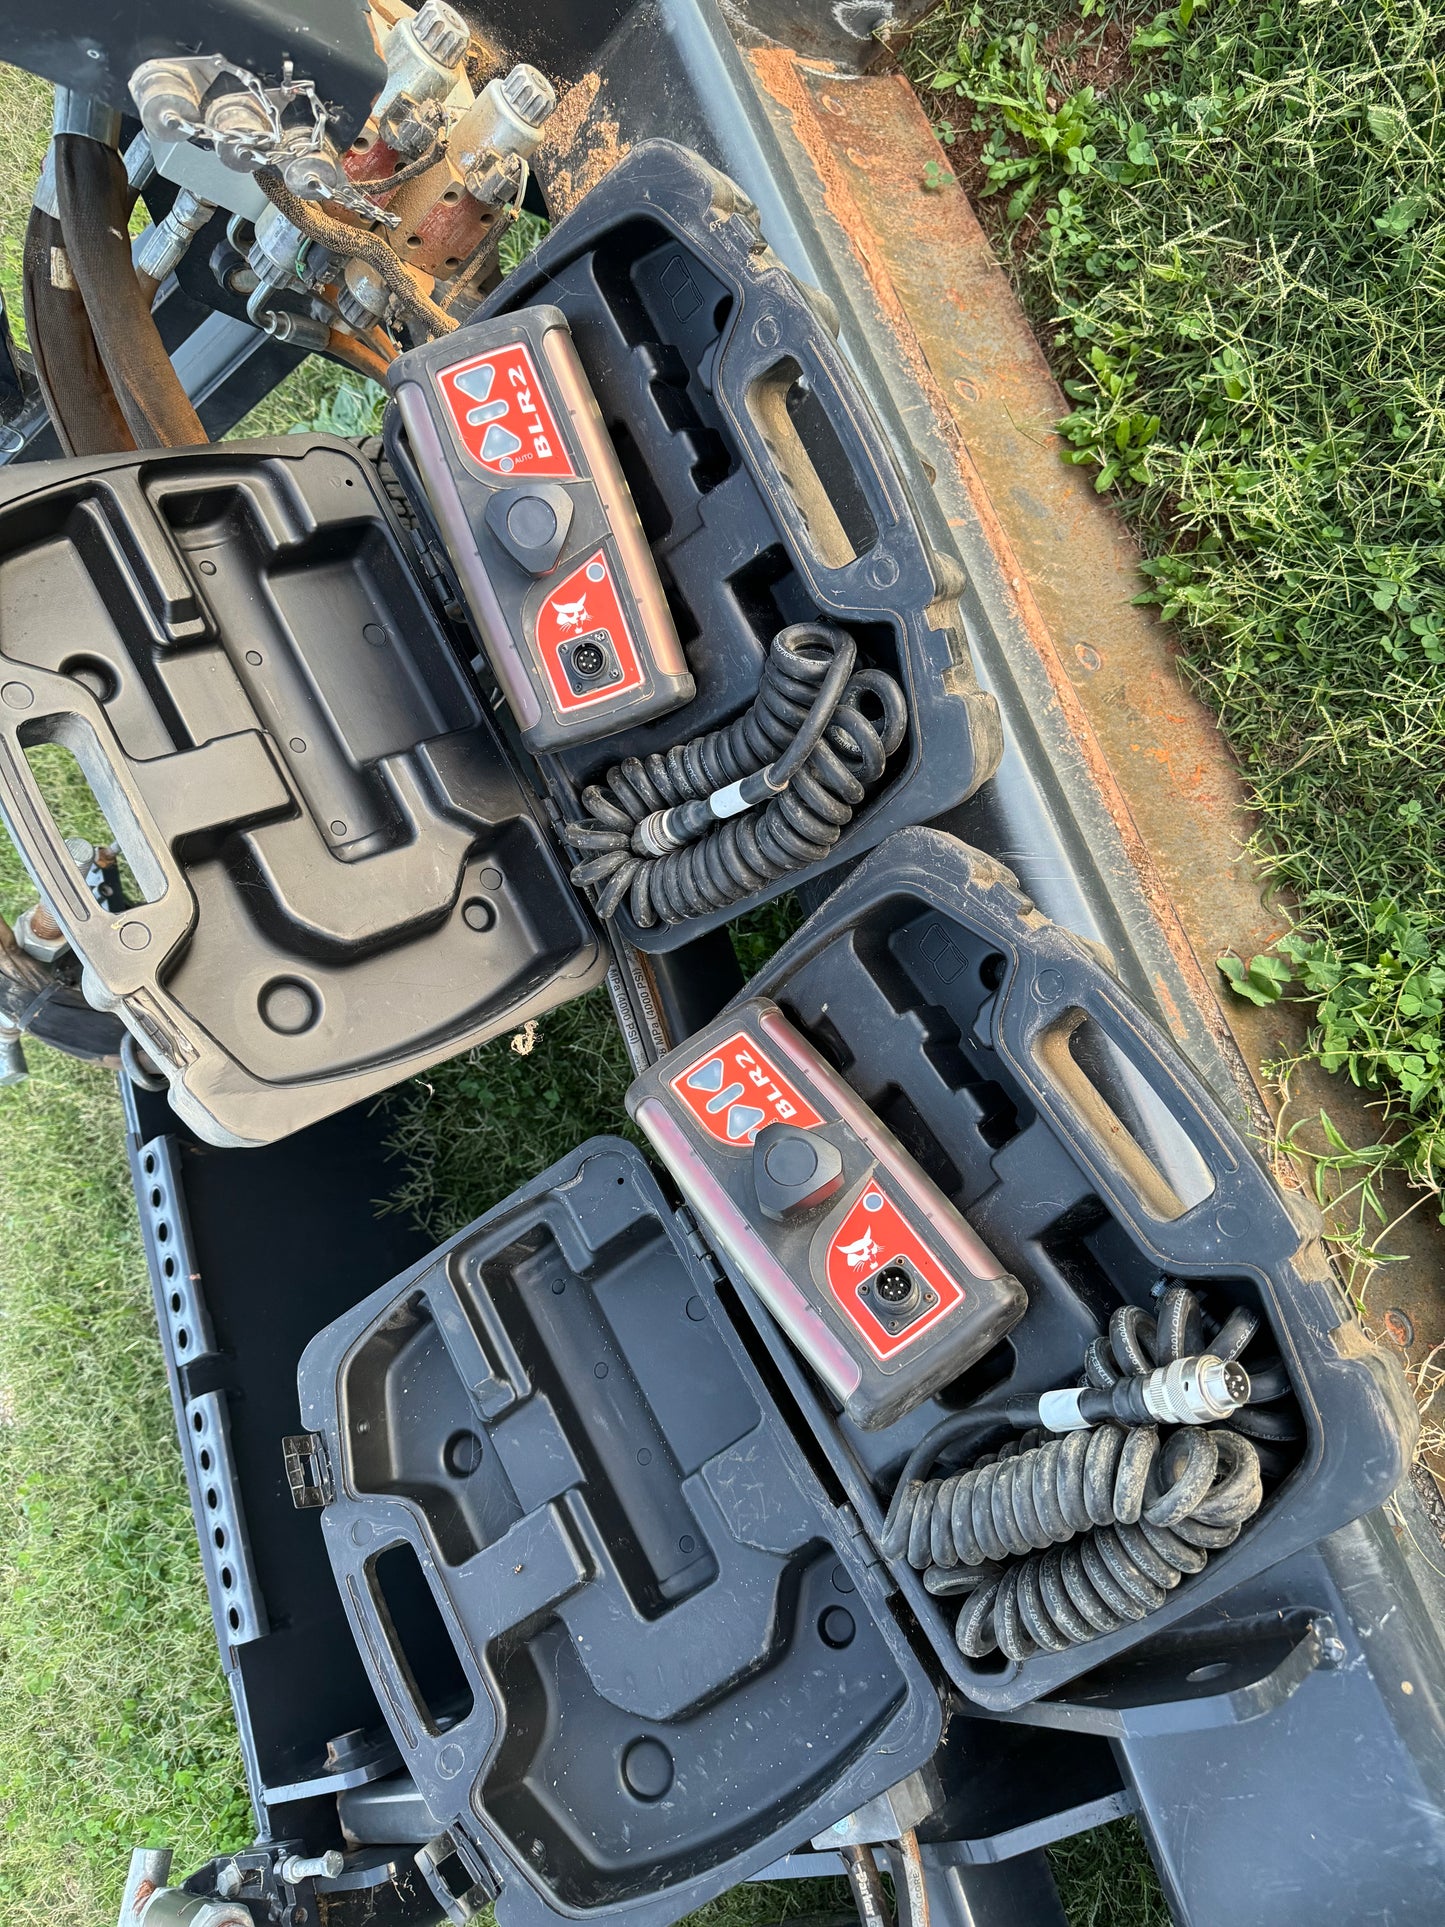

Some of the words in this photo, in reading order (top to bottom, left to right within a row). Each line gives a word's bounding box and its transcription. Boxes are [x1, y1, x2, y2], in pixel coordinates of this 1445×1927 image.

[509, 365, 553, 458] BLR2
[515, 452, 533, 464] AUTO
[632, 967, 647, 991] PSI)
[609, 968, 621, 992] MPa
[615, 992, 631, 1021] (4000
[626, 1023, 640, 1045] PSI)
[640, 991, 657, 1020] (4000
[651, 1023, 665, 1046] MPa
[734, 1049, 798, 1119] BLR2
[855, 1868, 876, 1917] Parker
